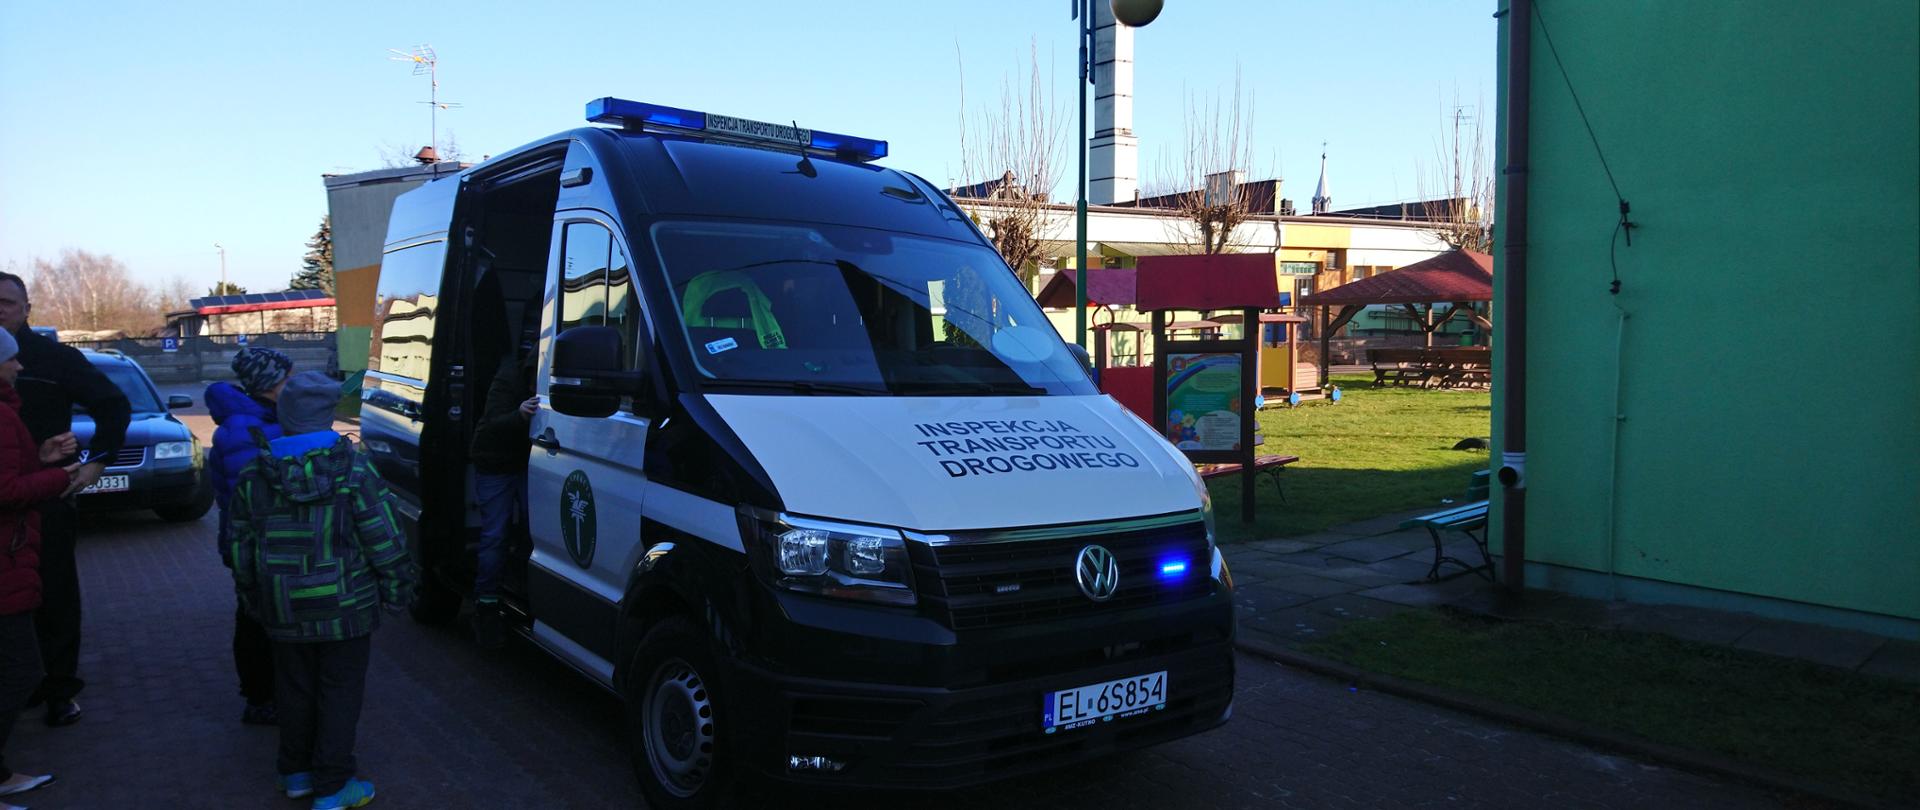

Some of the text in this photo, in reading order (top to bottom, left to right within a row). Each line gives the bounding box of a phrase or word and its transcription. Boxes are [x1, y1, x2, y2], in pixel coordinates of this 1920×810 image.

[707, 113, 810, 143] INSPEKCJA TRANSPORTU DROGOWEGO
[165, 338, 174, 348] P
[914, 420, 1081, 437] INSPEKCJA
[917, 435, 1117, 457] TRANSPORTU
[939, 452, 1140, 478] DROGOWEGO
[1059, 674, 1164, 721] EL 6S854
[1044, 713, 1053, 722] PL
